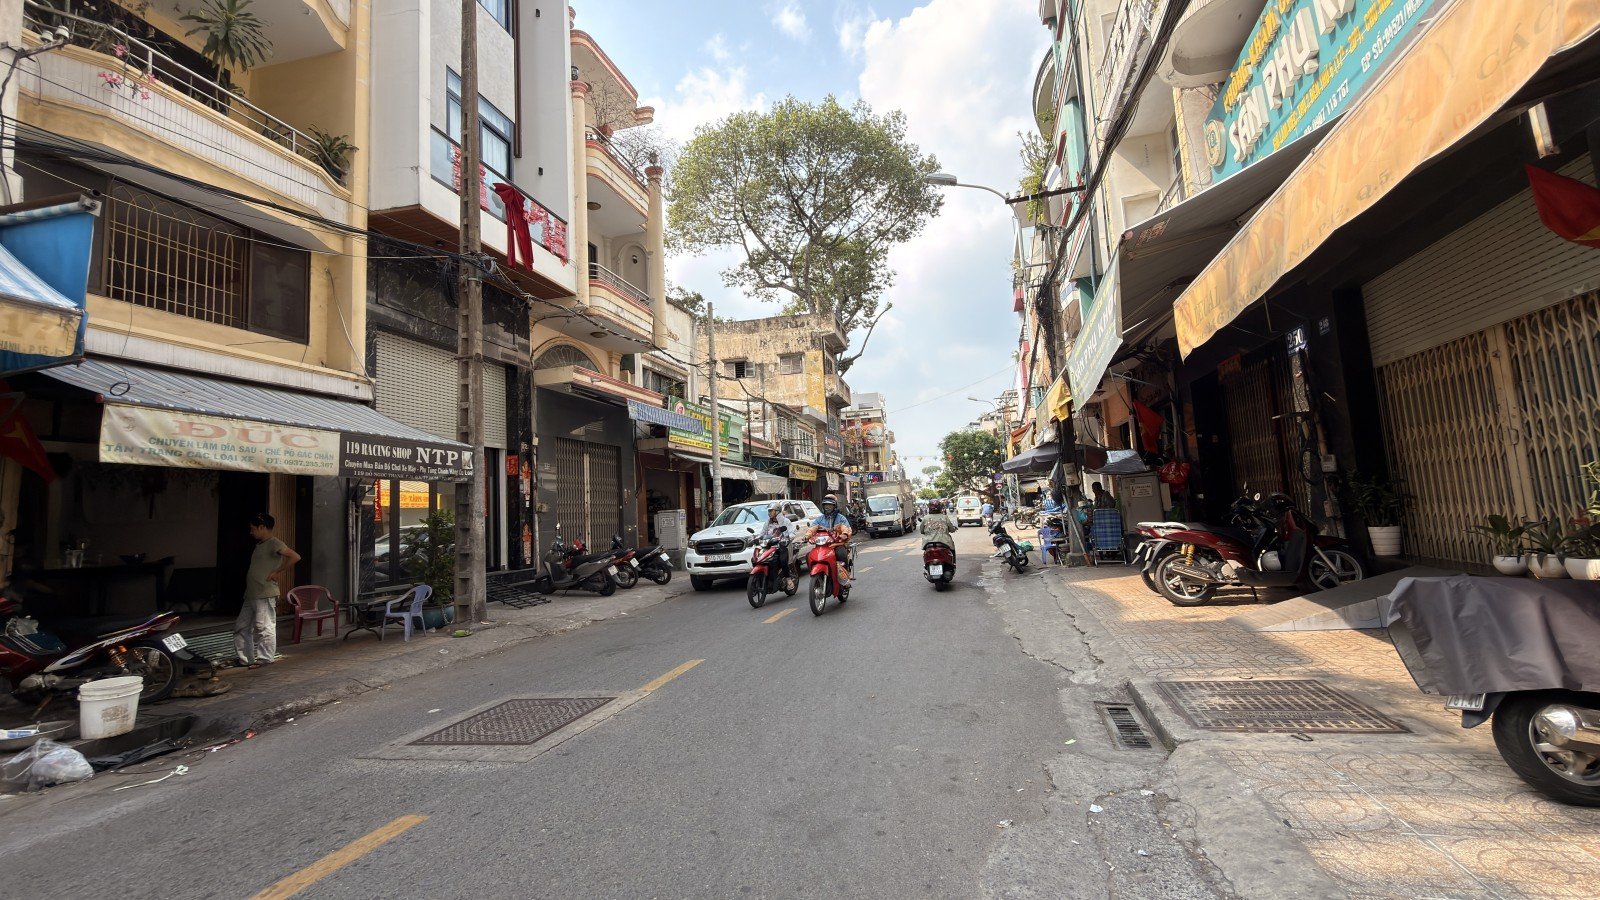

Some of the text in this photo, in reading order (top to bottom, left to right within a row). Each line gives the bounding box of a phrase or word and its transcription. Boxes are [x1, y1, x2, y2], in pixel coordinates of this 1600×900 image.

[1262, 7, 1319, 110] PHỤ
[1287, 328, 1304, 349] 250
[172, 420, 319, 449] ĐỨC
[346, 441, 459, 466] 119 RACING SHOP NTP
